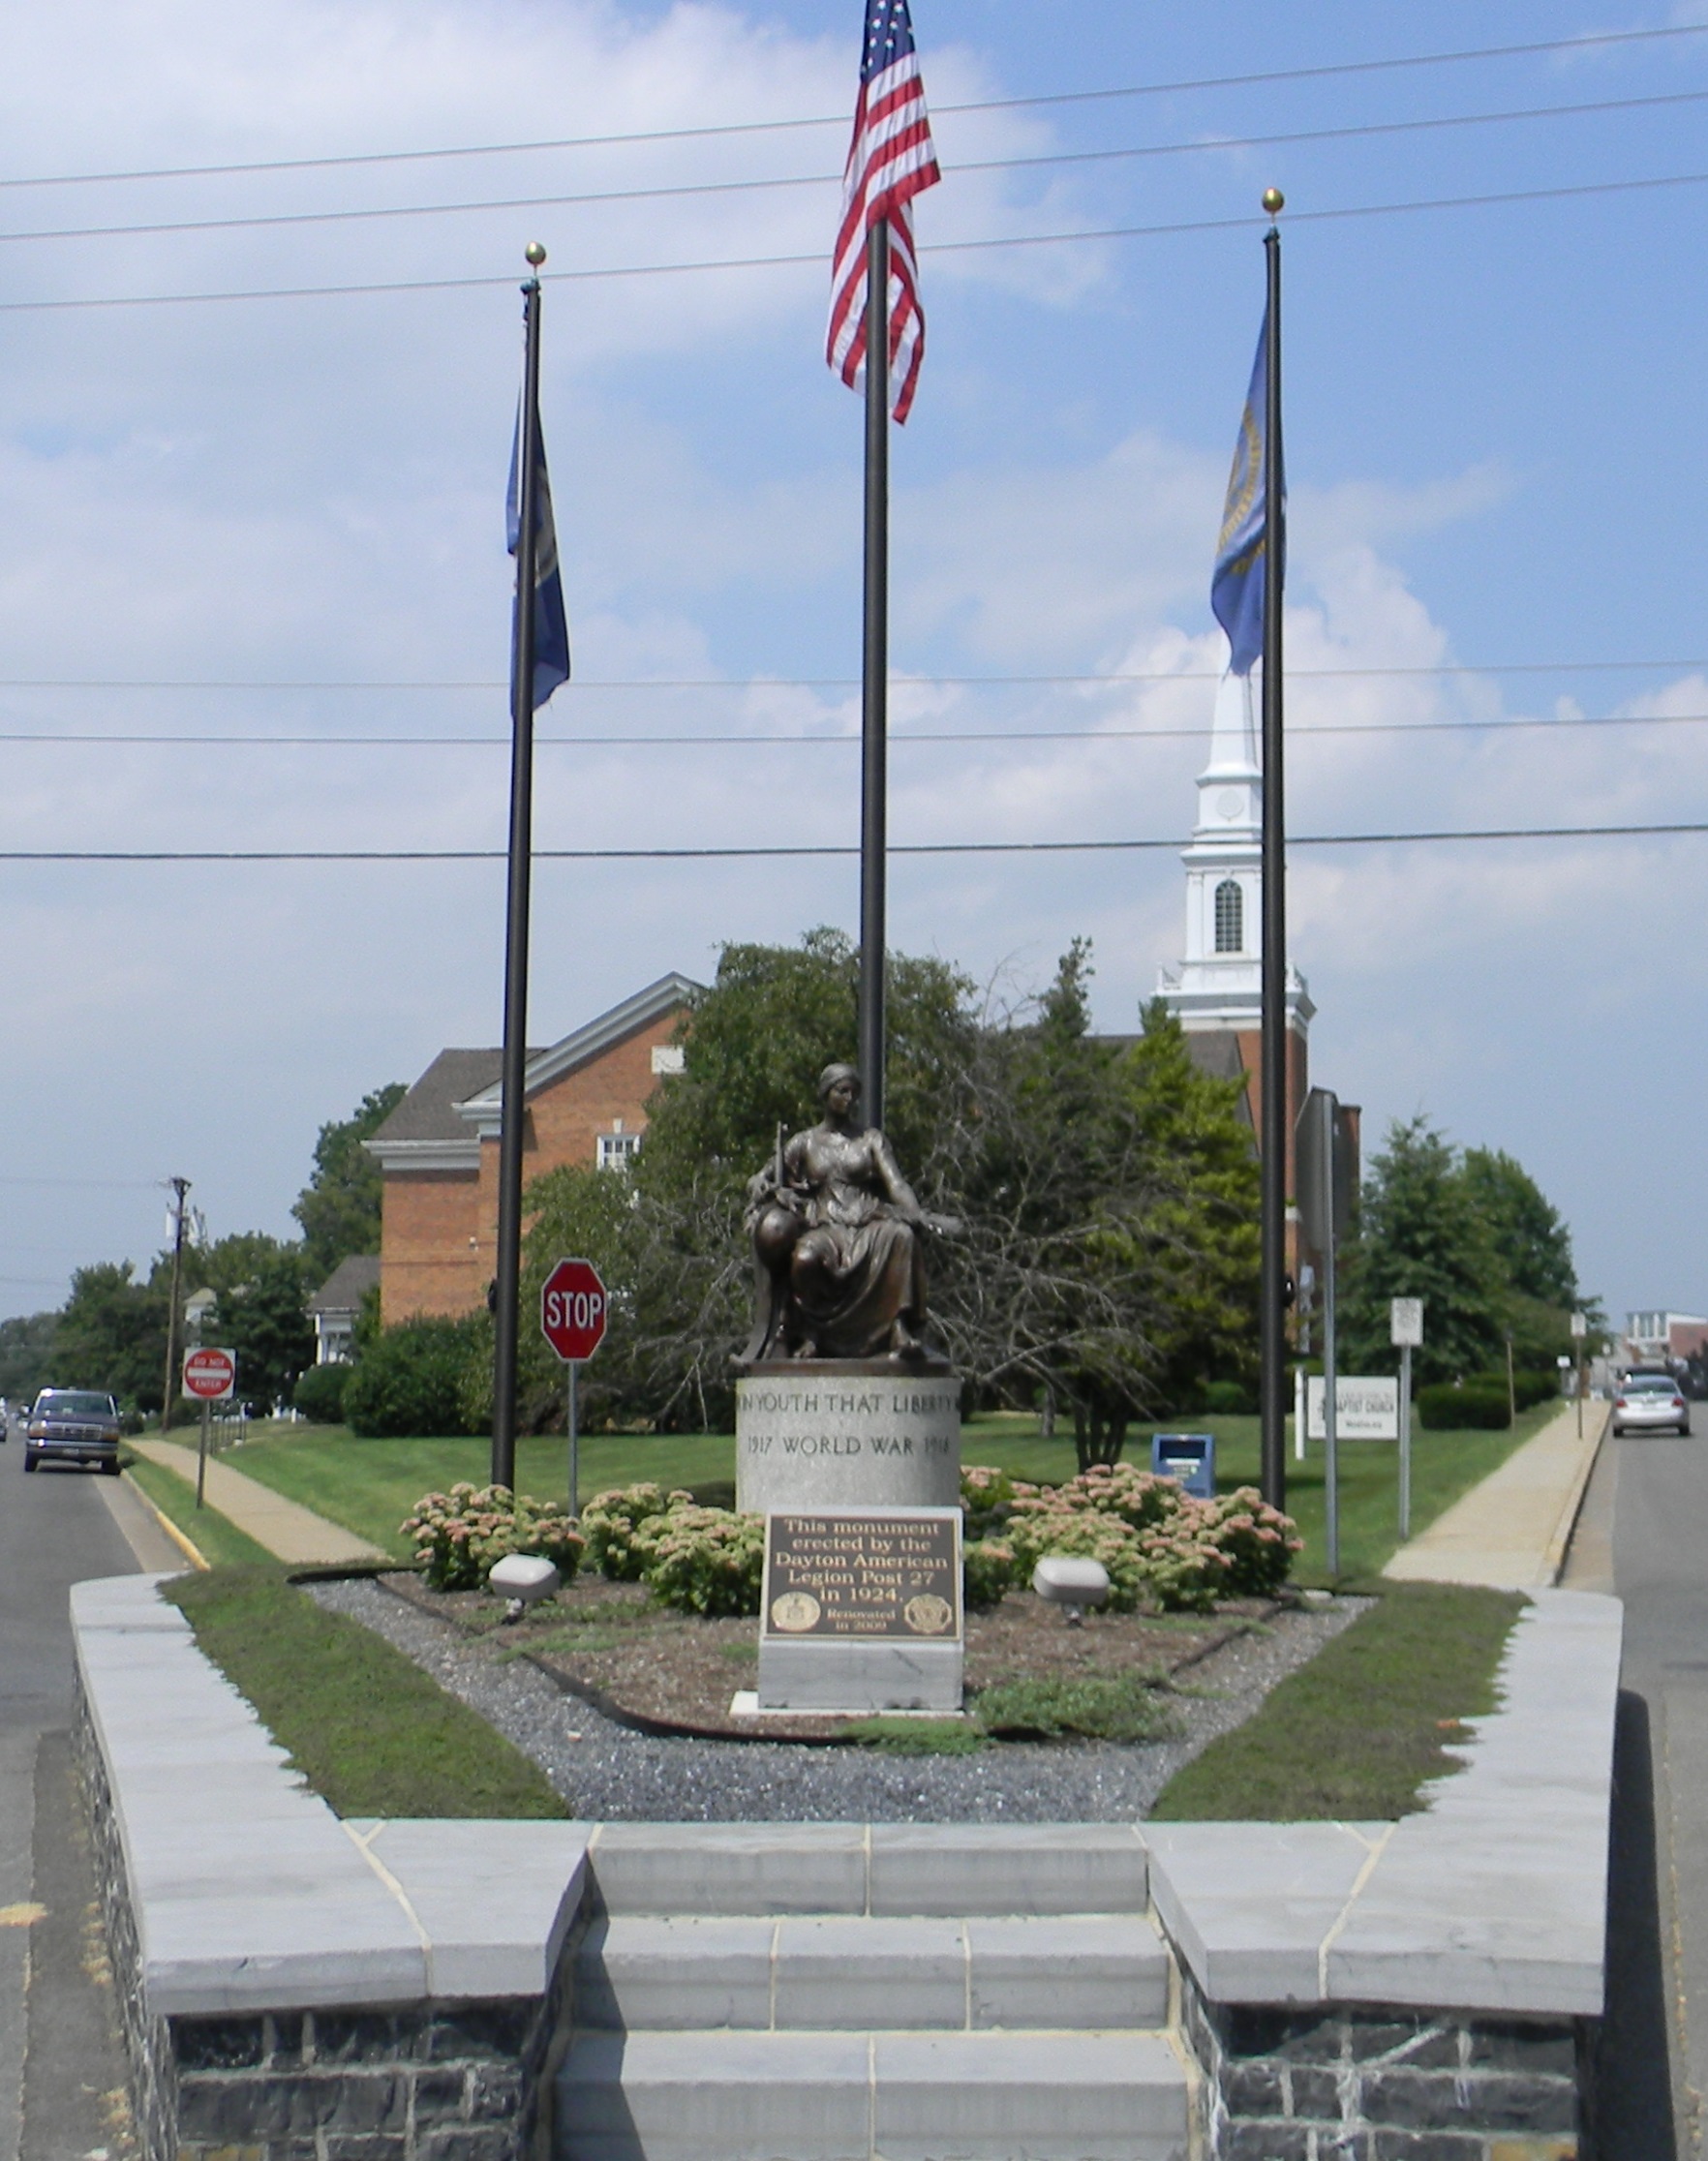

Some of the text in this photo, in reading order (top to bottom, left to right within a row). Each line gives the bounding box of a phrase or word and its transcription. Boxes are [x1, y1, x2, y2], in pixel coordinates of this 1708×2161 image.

[546, 1291, 602, 1329] STOP
[194, 1356, 226, 1367] DO NOT
[195, 1378, 222, 1387] ENTER
[755, 1392, 818, 1414] YOUTH
[824, 1394, 883, 1414] THAT
[747, 1435, 774, 1455] 1917
[782, 1436, 862, 1456] WORLD
[871, 1436, 914, 1455] WAR
[784, 1518, 940, 1536] This monument
[792, 1537, 931, 1554] erected by the
[776, 1552, 948, 1569] Dayton American
[788, 1569, 935, 1586] Legion Post 27
[819, 1587, 903, 1603] in 1924.
[827, 1608, 897, 1621] Renovated
[836, 1622, 849, 1630] in
